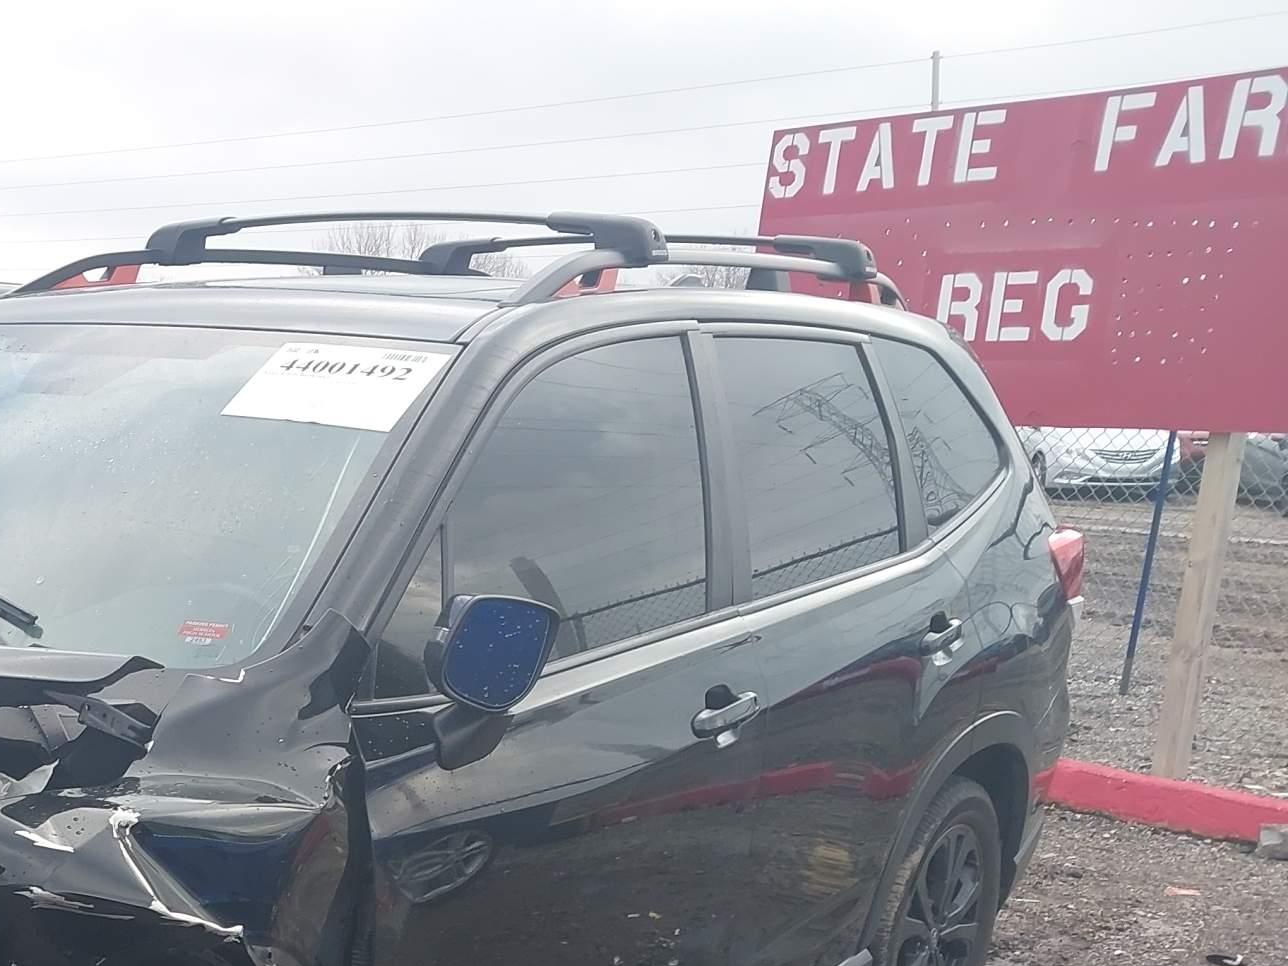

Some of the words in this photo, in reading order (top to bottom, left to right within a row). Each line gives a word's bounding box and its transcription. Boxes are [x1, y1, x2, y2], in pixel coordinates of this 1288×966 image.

[768, 109, 1007, 199] STATE
[1094, 74, 1288, 172] FAR
[936, 268, 1094, 342] REG
[279, 358, 413, 381] 44001492
